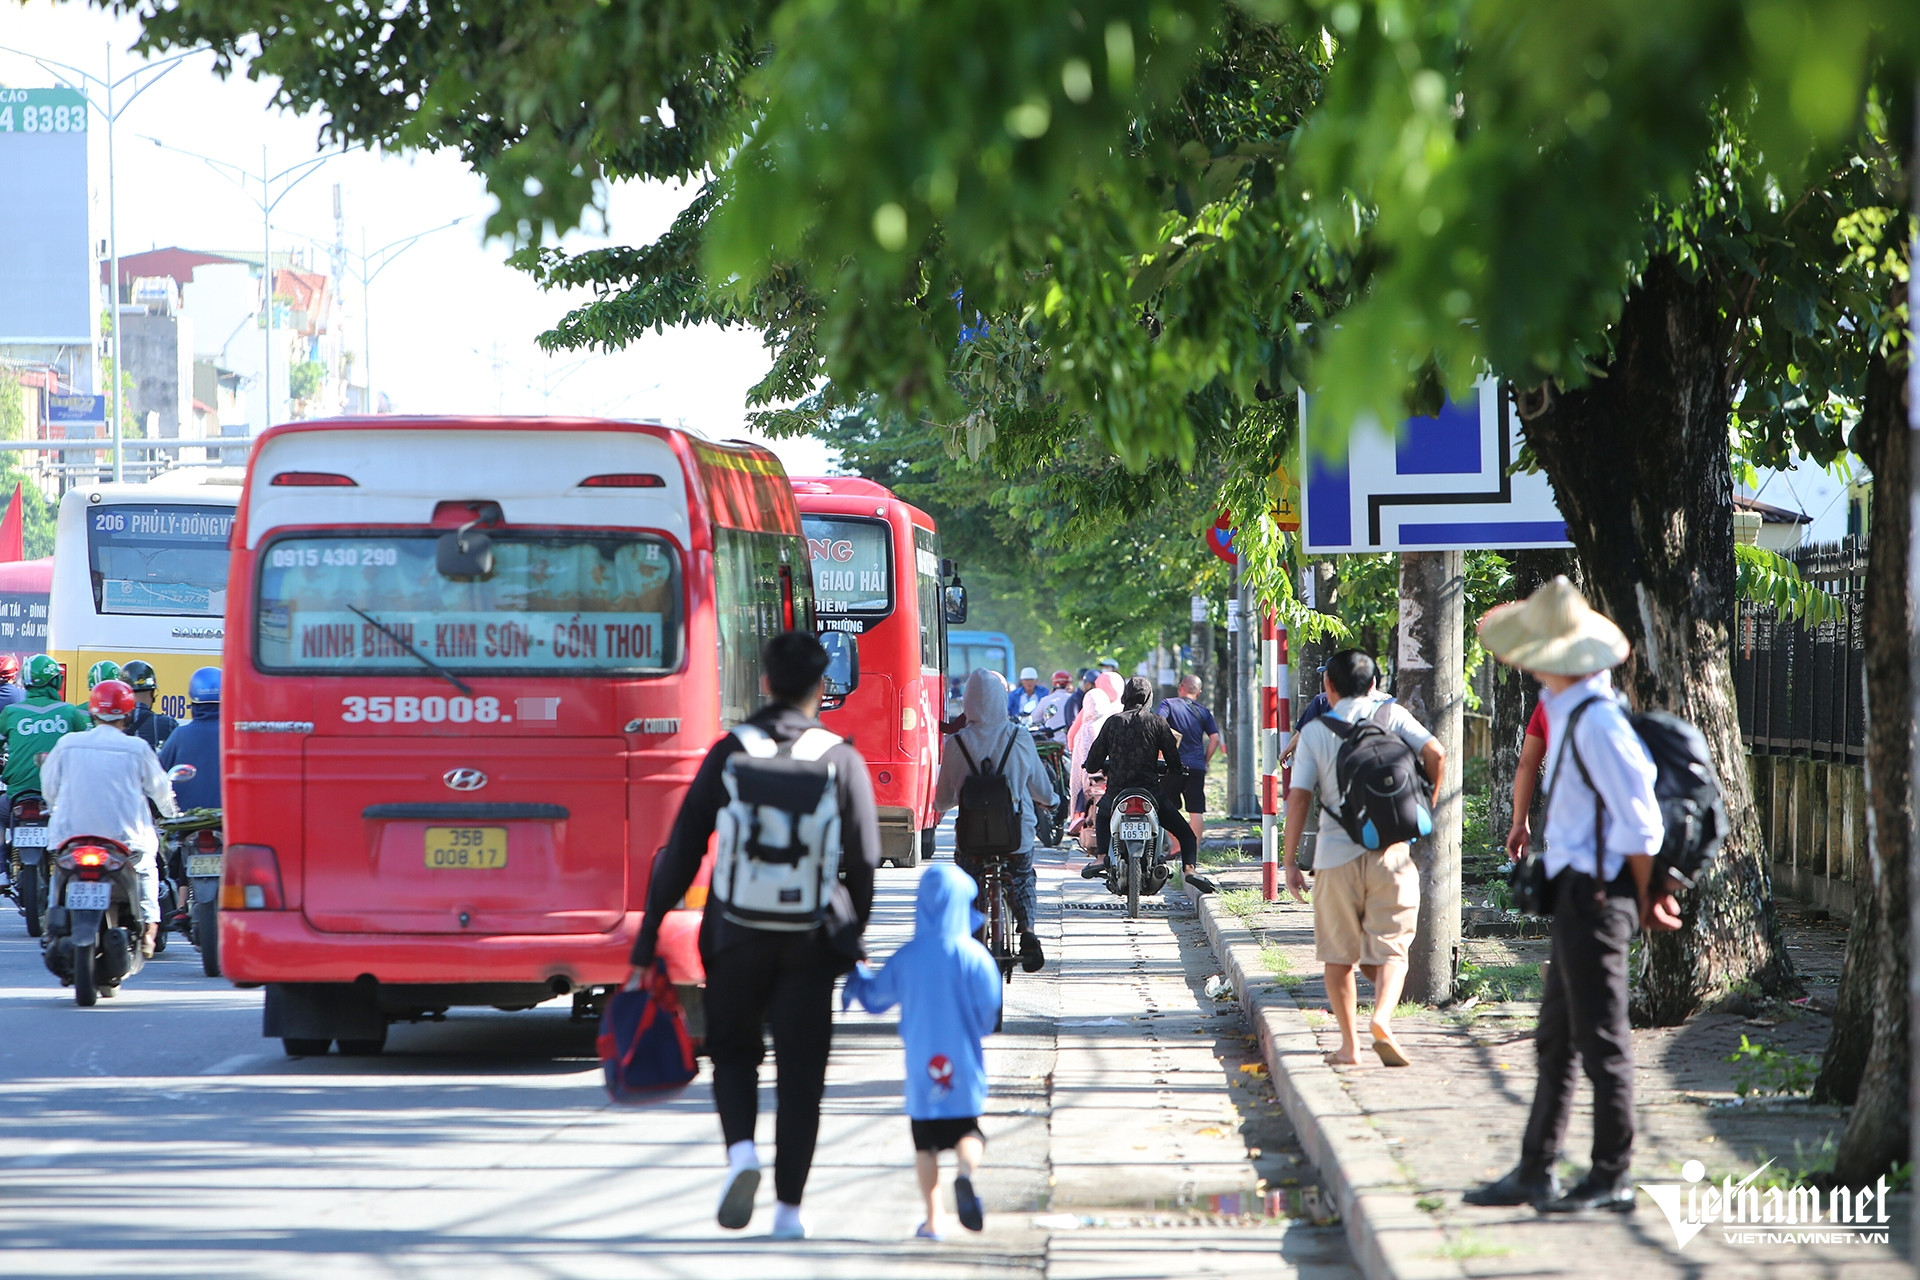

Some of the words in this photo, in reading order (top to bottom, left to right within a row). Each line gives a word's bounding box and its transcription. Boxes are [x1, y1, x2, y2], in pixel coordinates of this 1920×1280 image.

[23, 105, 86, 133] 8383
[95, 514, 125, 531] 206
[272, 549, 319, 567] 0915
[323, 549, 357, 566] 430
[361, 548, 397, 566] 290
[807, 538, 855, 562] NG
[819, 570, 855, 592] GIAO
[860, 562, 886, 592] HẢI
[171, 626, 224, 639] SAMCO
[825, 617, 863, 633] TRƯỜNG
[302, 624, 355, 658] NINH
[435, 623, 477, 657] KIM
[484, 620, 529, 658] SƠN
[604, 623, 652, 658] THOI
[341, 696, 561, 723] 35B008.
[17, 714, 69, 735] Grab
[644, 718, 681, 734] COUNTY
[449, 829, 484, 846] 35B
[434, 848, 497, 866] 008.17
